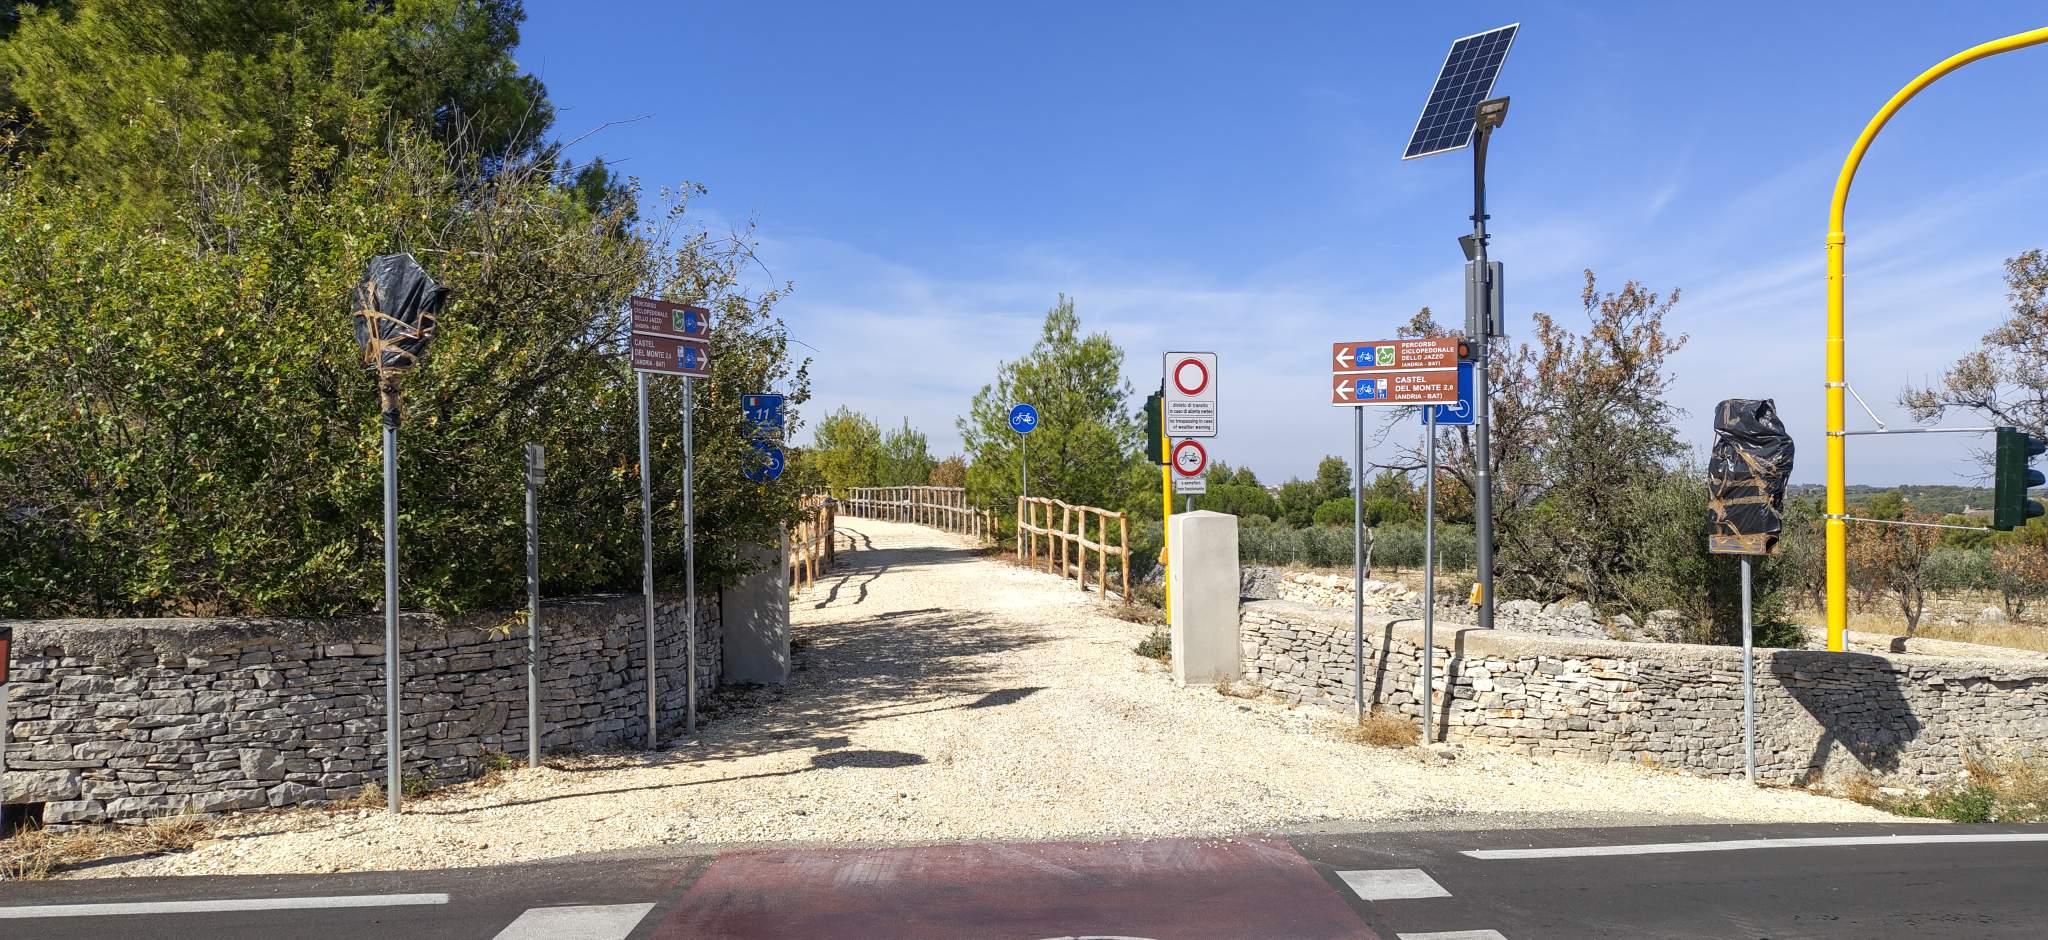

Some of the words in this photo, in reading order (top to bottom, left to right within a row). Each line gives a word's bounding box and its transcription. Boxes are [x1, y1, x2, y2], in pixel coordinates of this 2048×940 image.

[634, 338, 655, 348] CASTEL
[634, 348, 645, 357] DEL
[646, 350, 664, 359] MONTE
[1401, 347, 1455, 355] CICLOPEDONALE
[757, 407, 770, 420] 11
